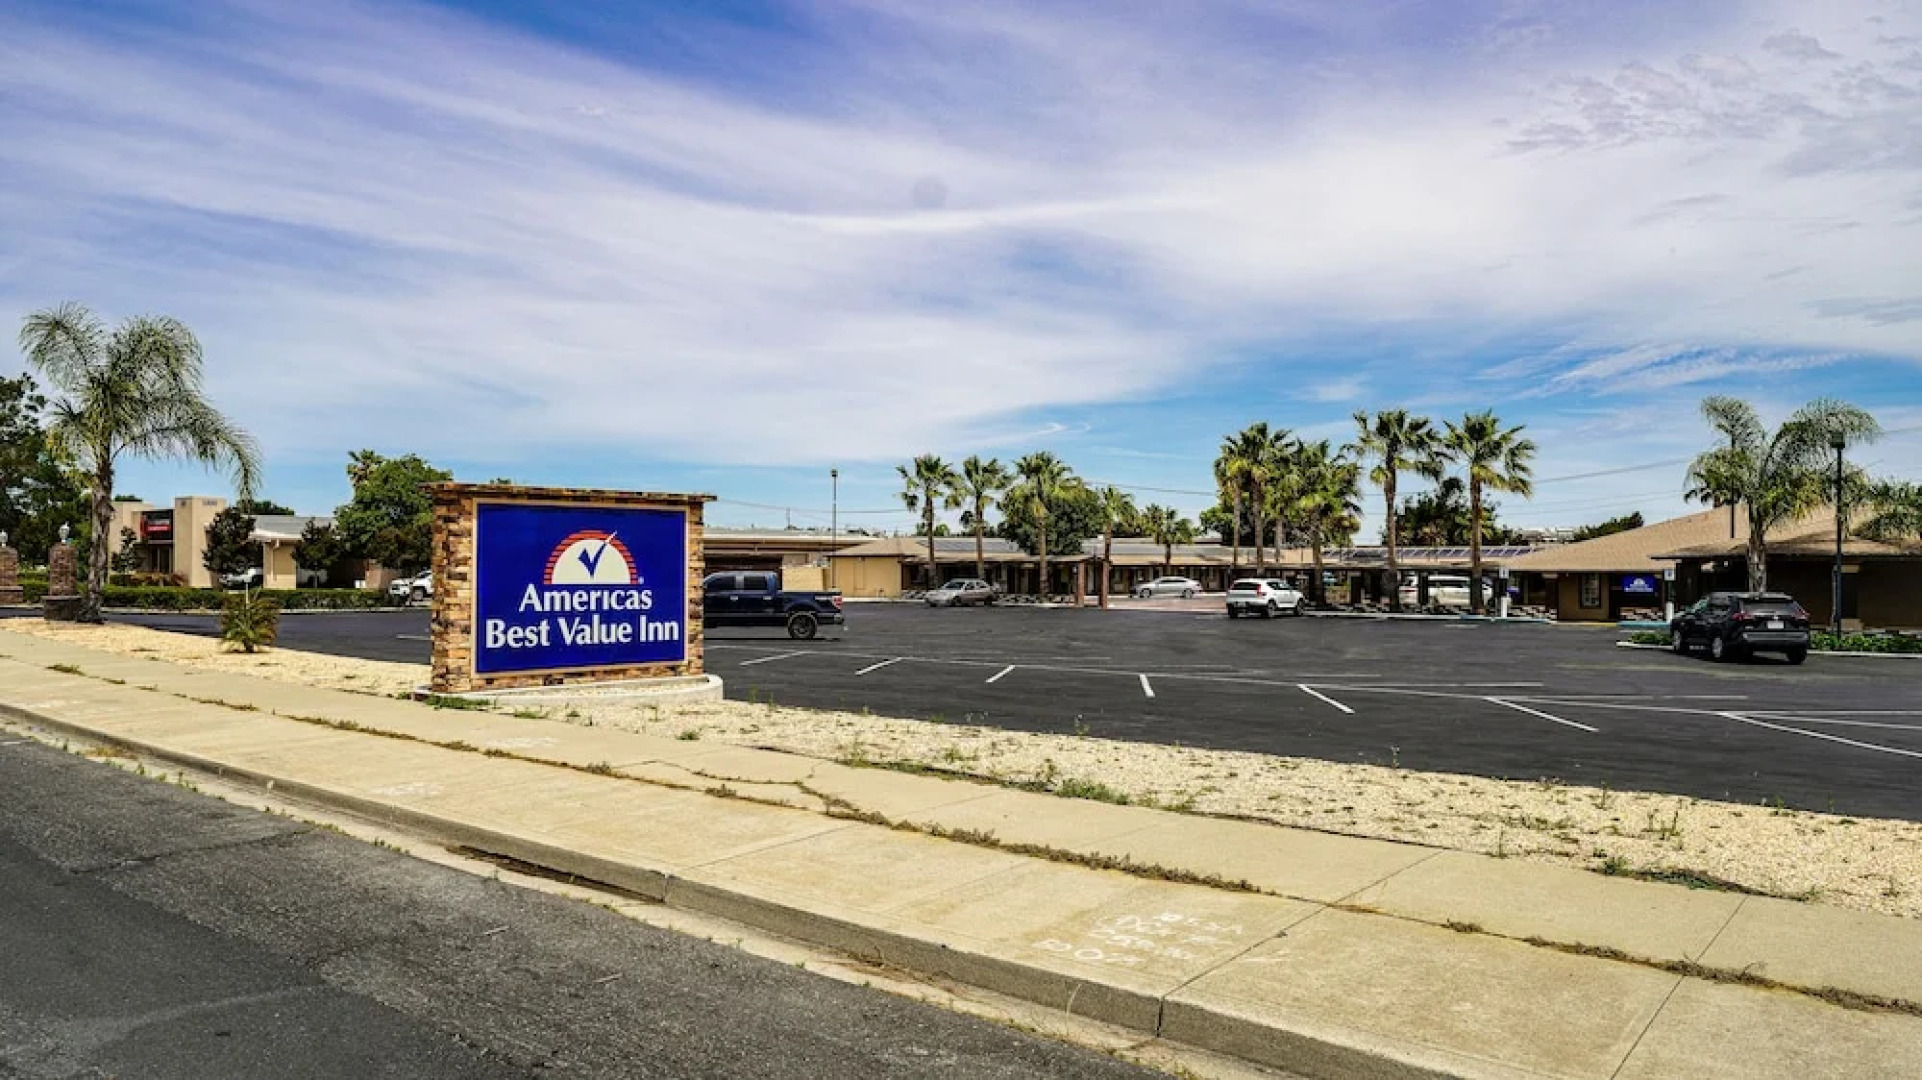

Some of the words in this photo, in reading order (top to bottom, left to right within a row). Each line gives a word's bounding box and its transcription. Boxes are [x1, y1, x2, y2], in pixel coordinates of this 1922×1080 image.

[519, 583, 653, 612] Americas
[485, 618, 551, 649] Best
[557, 614, 633, 646] Value
[639, 615, 679, 643] Inn
